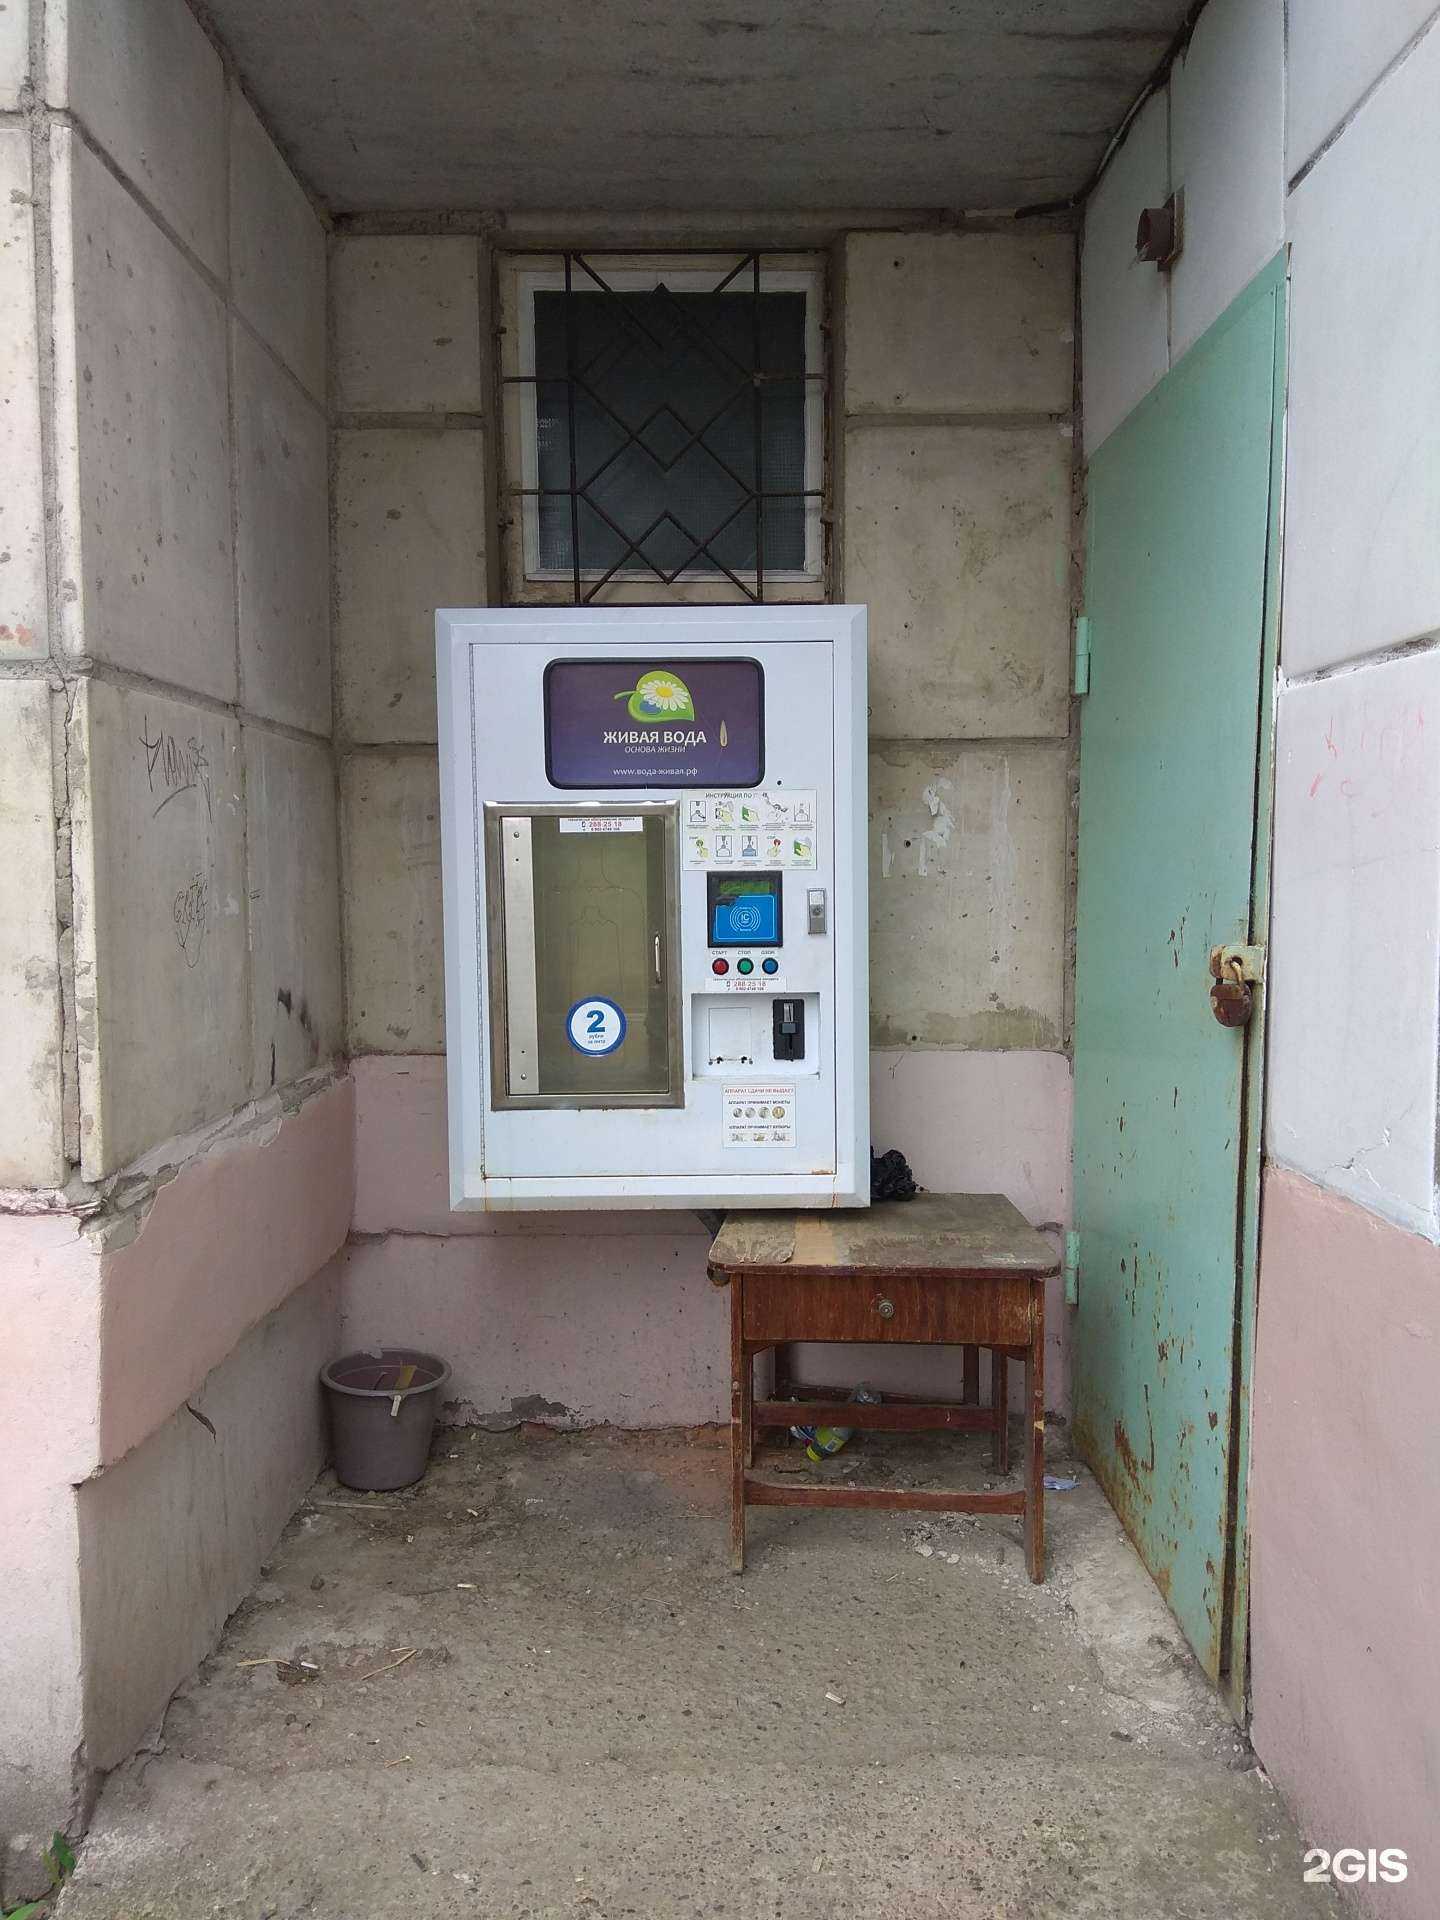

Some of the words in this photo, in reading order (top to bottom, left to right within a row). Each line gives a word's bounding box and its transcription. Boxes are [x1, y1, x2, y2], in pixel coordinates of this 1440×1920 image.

[603, 731, 659, 744] ЖИВАЯ
[663, 731, 707, 747] ВОДА
[586, 1010, 606, 1033] 2
